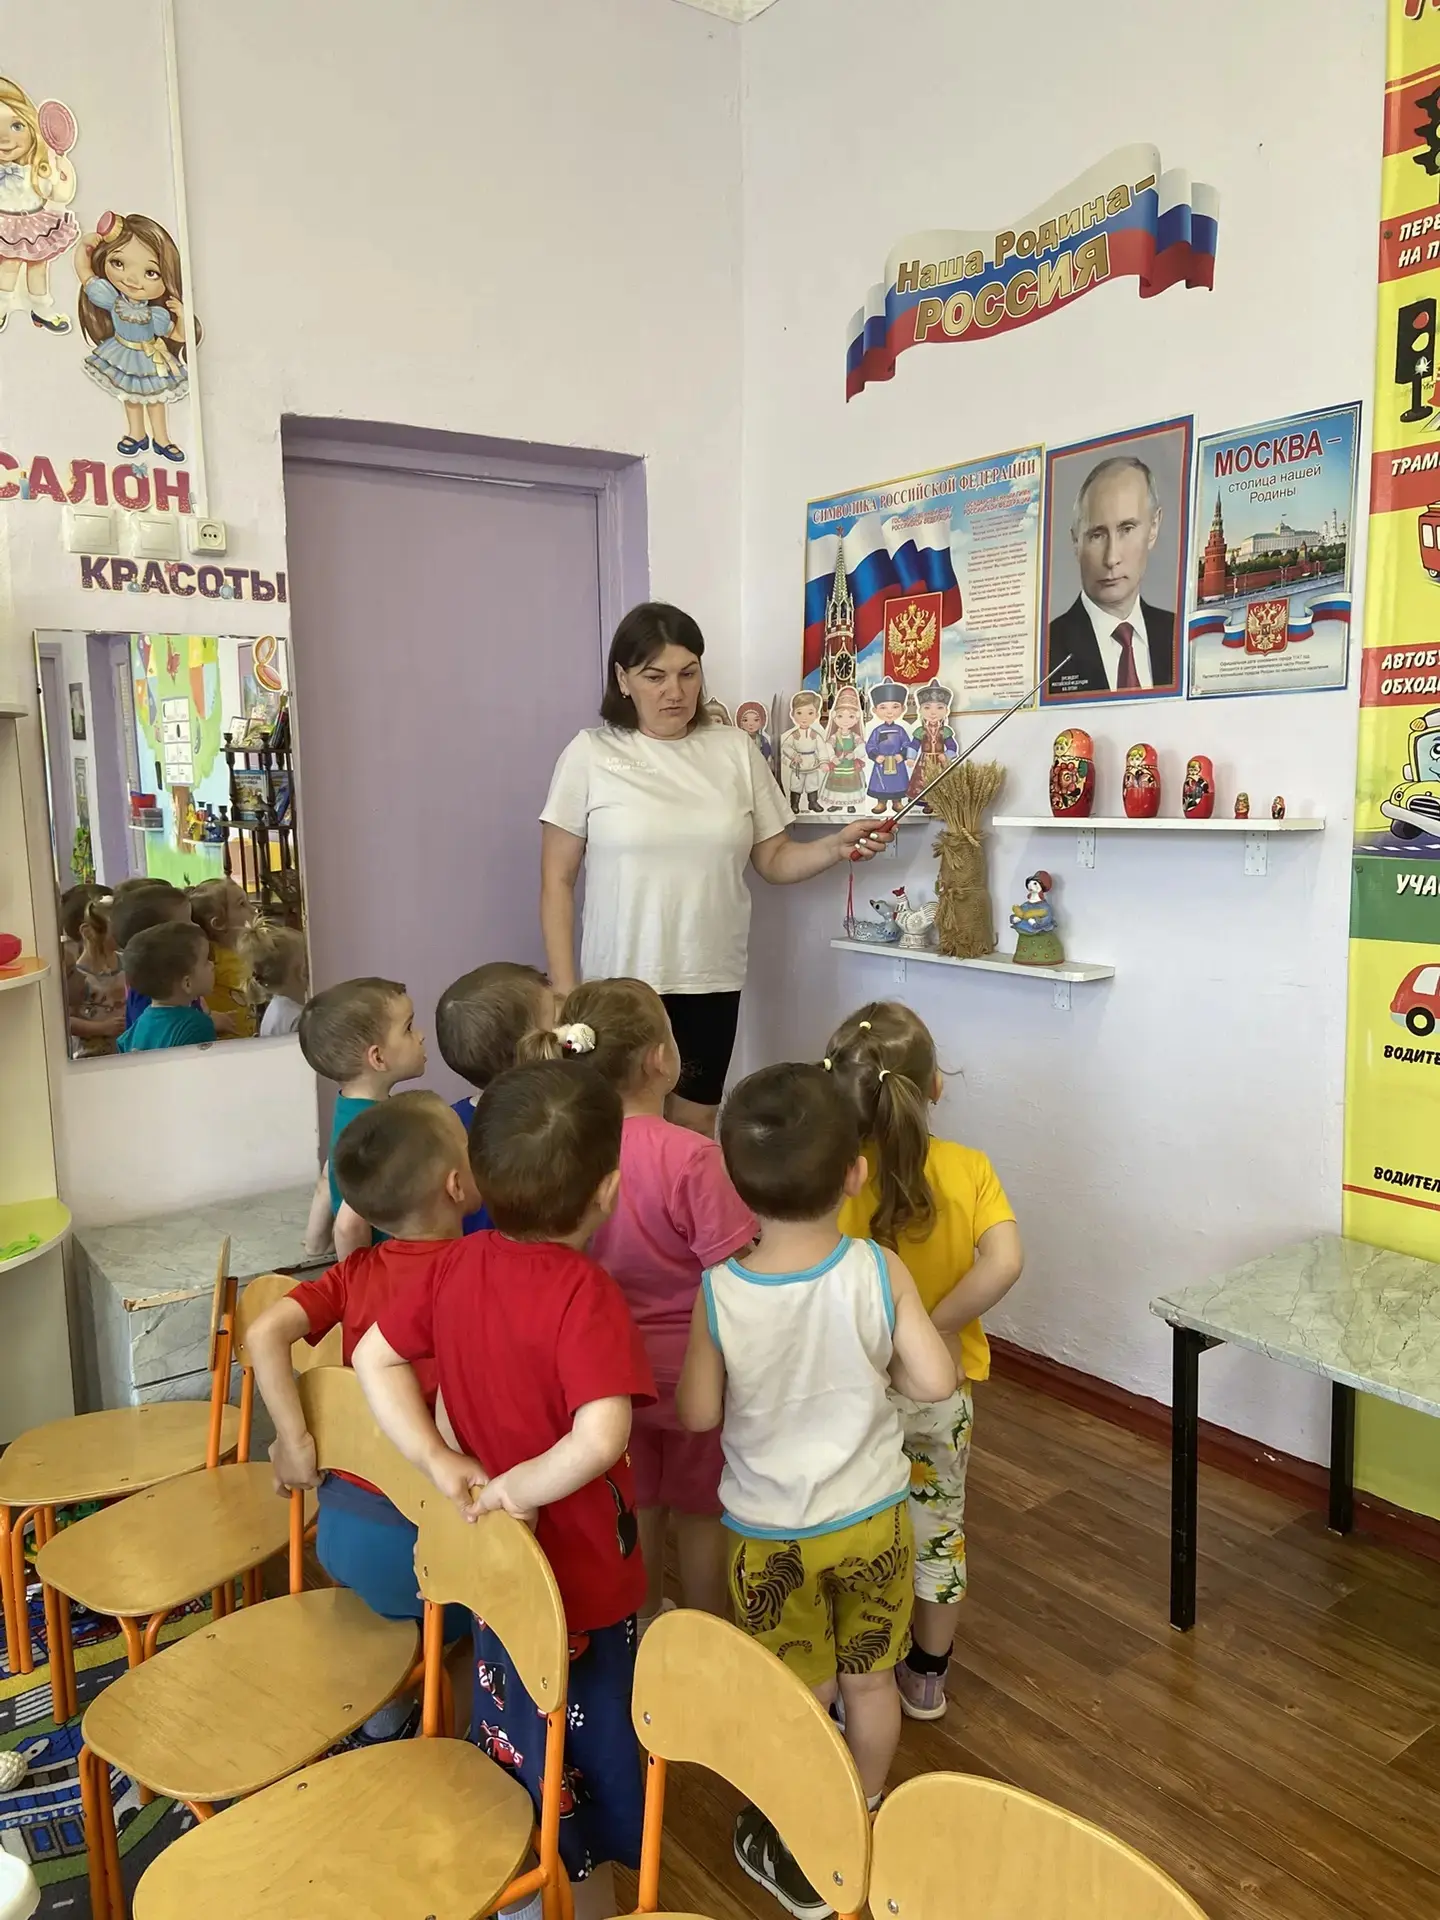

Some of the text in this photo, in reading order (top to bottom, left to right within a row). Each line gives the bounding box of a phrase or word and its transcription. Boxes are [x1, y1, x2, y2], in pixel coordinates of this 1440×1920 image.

[1398, 246, 1422, 268] НА
[897, 250, 984, 293] Наша
[914, 233, 1110, 340] РОССИЯ
[1215, 430, 1323, 477] МОСКВА
[1391, 452, 1440, 476] ТРАМ
[813, 459, 1035, 523] СИМВОЛИКА РОССИЙСКОЙ ФЕДЕРАЦИИ
[1228, 464, 1321, 493] столица нашей
[1249, 487, 1297, 503] Родины
[80, 555, 287, 603] КРАСОТЫ
[1381, 649, 1440, 670] АВТОБ
[1381, 676, 1440, 695] ОБХОД
[1396, 873, 1440, 896] УЧА
